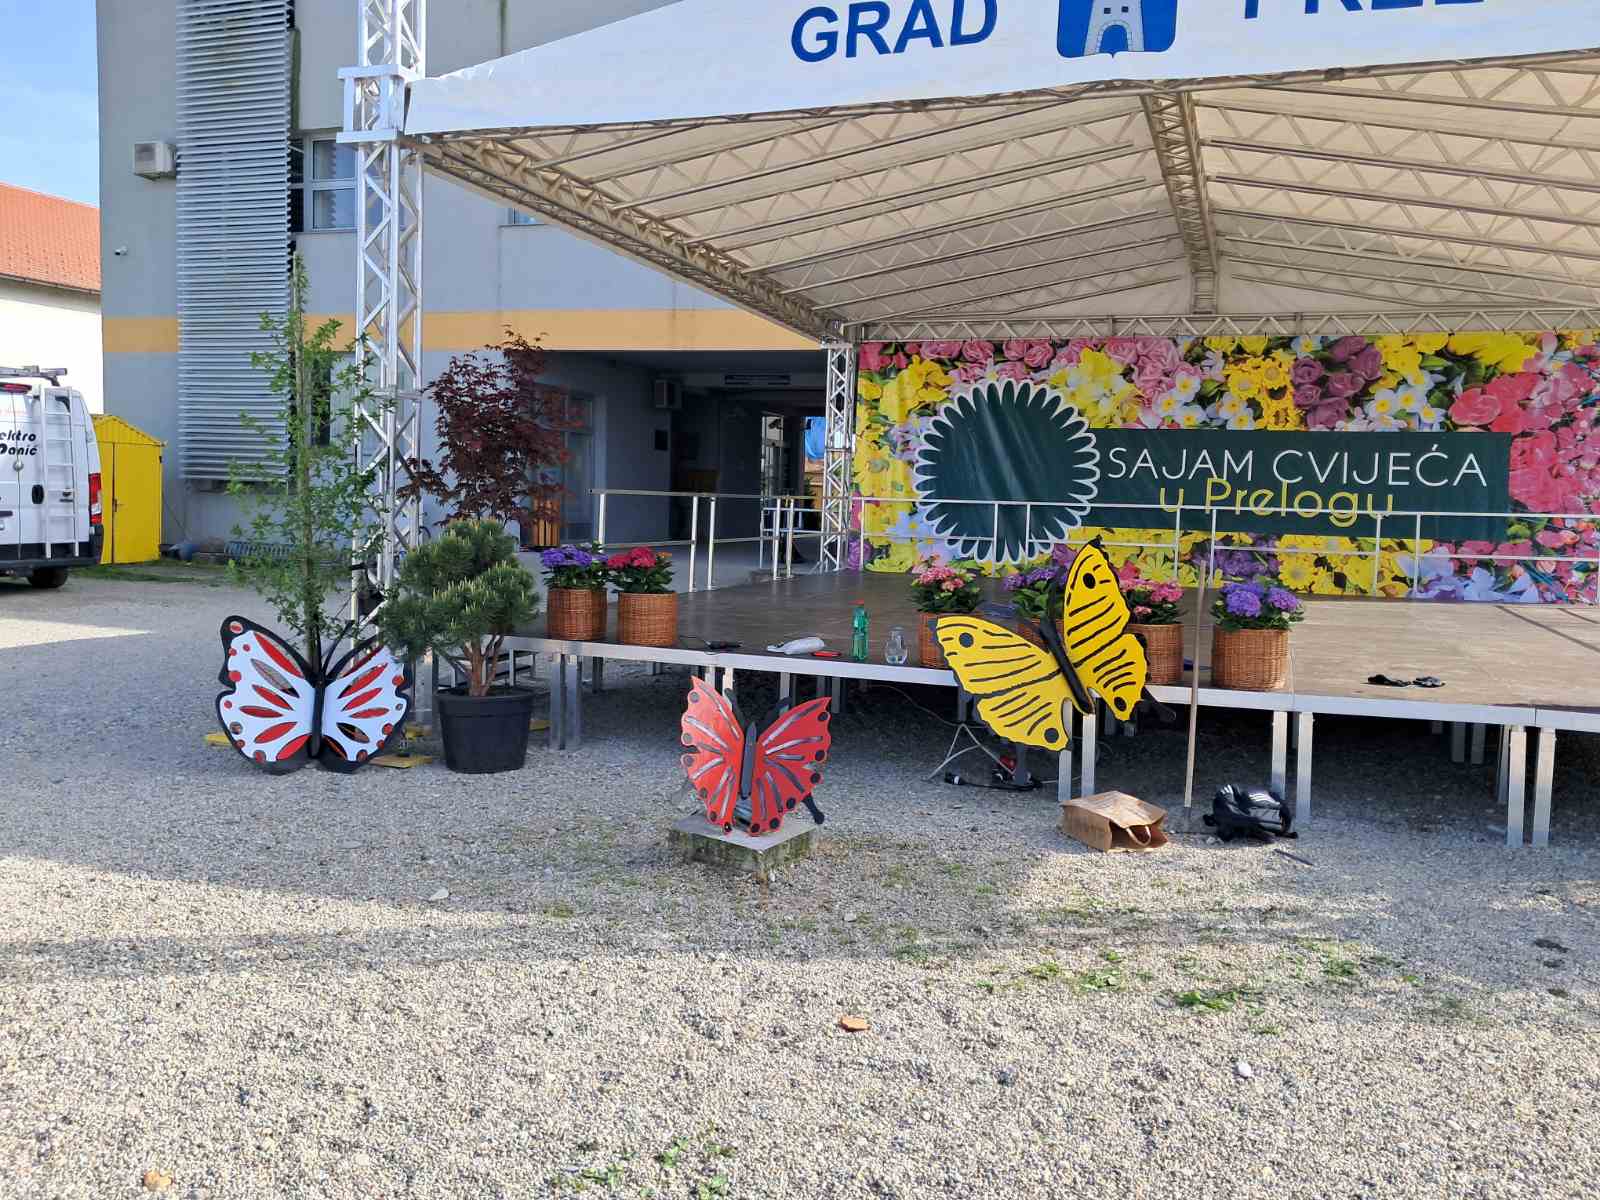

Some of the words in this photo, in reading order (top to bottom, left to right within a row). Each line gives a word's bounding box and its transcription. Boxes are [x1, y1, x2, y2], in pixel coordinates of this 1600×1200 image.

[791, 0, 998, 63] GRAD
[1108, 447, 1254, 482] SAJAM
[1273, 444, 1487, 487] CVIJEĆA
[1160, 488, 1185, 513] u
[1204, 477, 1394, 528] Prelogu
